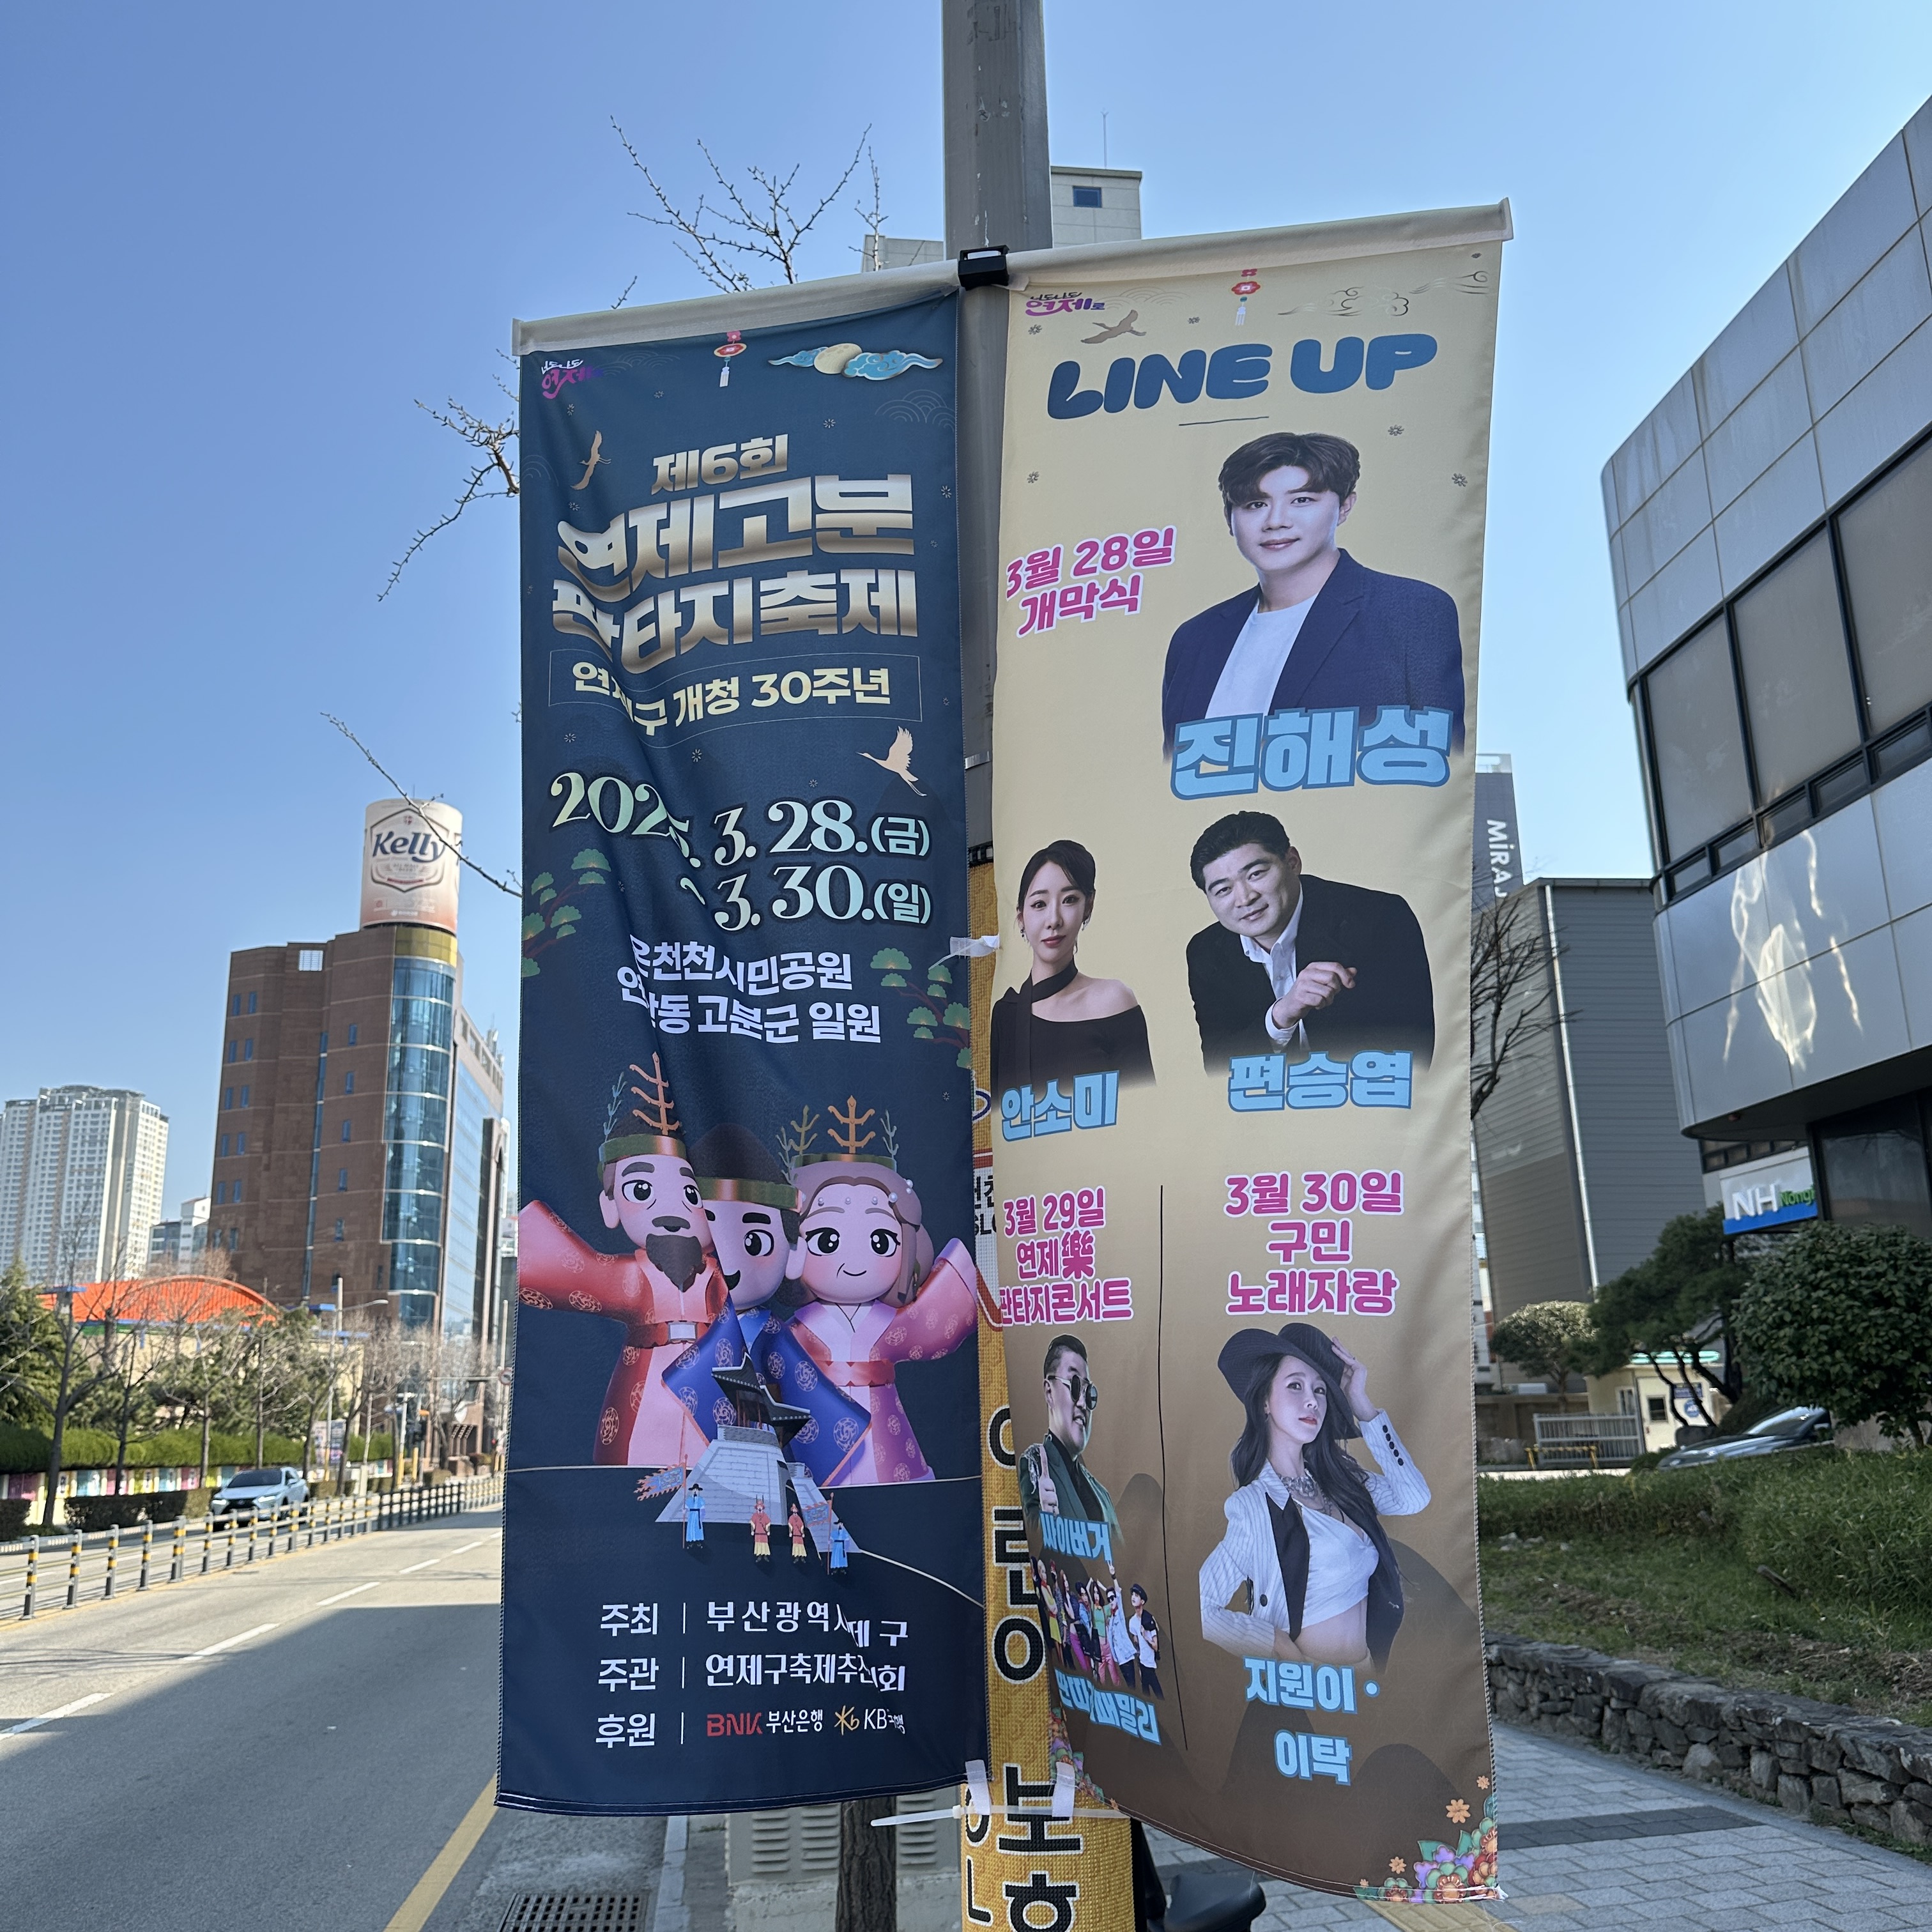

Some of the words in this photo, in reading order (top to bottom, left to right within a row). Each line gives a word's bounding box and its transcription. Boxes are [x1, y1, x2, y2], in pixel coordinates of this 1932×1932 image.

[1048, 343, 1273, 419] LINE
[1290, 334, 1438, 394] UP
[652, 434, 788, 494] 제6회
[557, 475, 915, 602] 연제고분
[1006, 546, 1062, 597] 3월
[1074, 527, 1175, 572] 28일
[1019, 574, 1143, 636] 개막식
[673, 677, 740, 727] 개청
[751, 667, 891, 707] 30주년
[1171, 705, 1453, 800] 진해성
[372, 831, 445, 863] Kelly
[697, 995, 800, 1043] 고분군
[808, 1001, 882, 1043] 일원
[1228, 1050, 1413, 1112] 편승엽
[1001, 1070, 1119, 1142] 안소미
[1003, 1196, 1037, 1236] 3월
[1043, 1188, 1105, 1230] 29일
[1225, 1172, 1289, 1215] 3월
[1302, 1171, 1402, 1213] 30일
[1732, 1183, 1779, 1221] NH
[1016, 1230, 1094, 1279] 연제樂
[1268, 1220, 1351, 1262] 구민
[999, 1280, 1132, 1324] 판타지콘서트
[1229, 1270, 1399, 1314] 노래자랑
[1039, 1511, 1113, 1561] 싸이버거
[601, 1603, 659, 1635] 주최
[847, 1620, 908, 1648] 제구
[598, 1659, 659, 1692] 주관
[595, 1713, 656, 1748] 후원
[707, 1713, 763, 1736] BNK
[766, 1709, 824, 1734] 부산은행
[1274, 1729, 1353, 1785] 이탁
